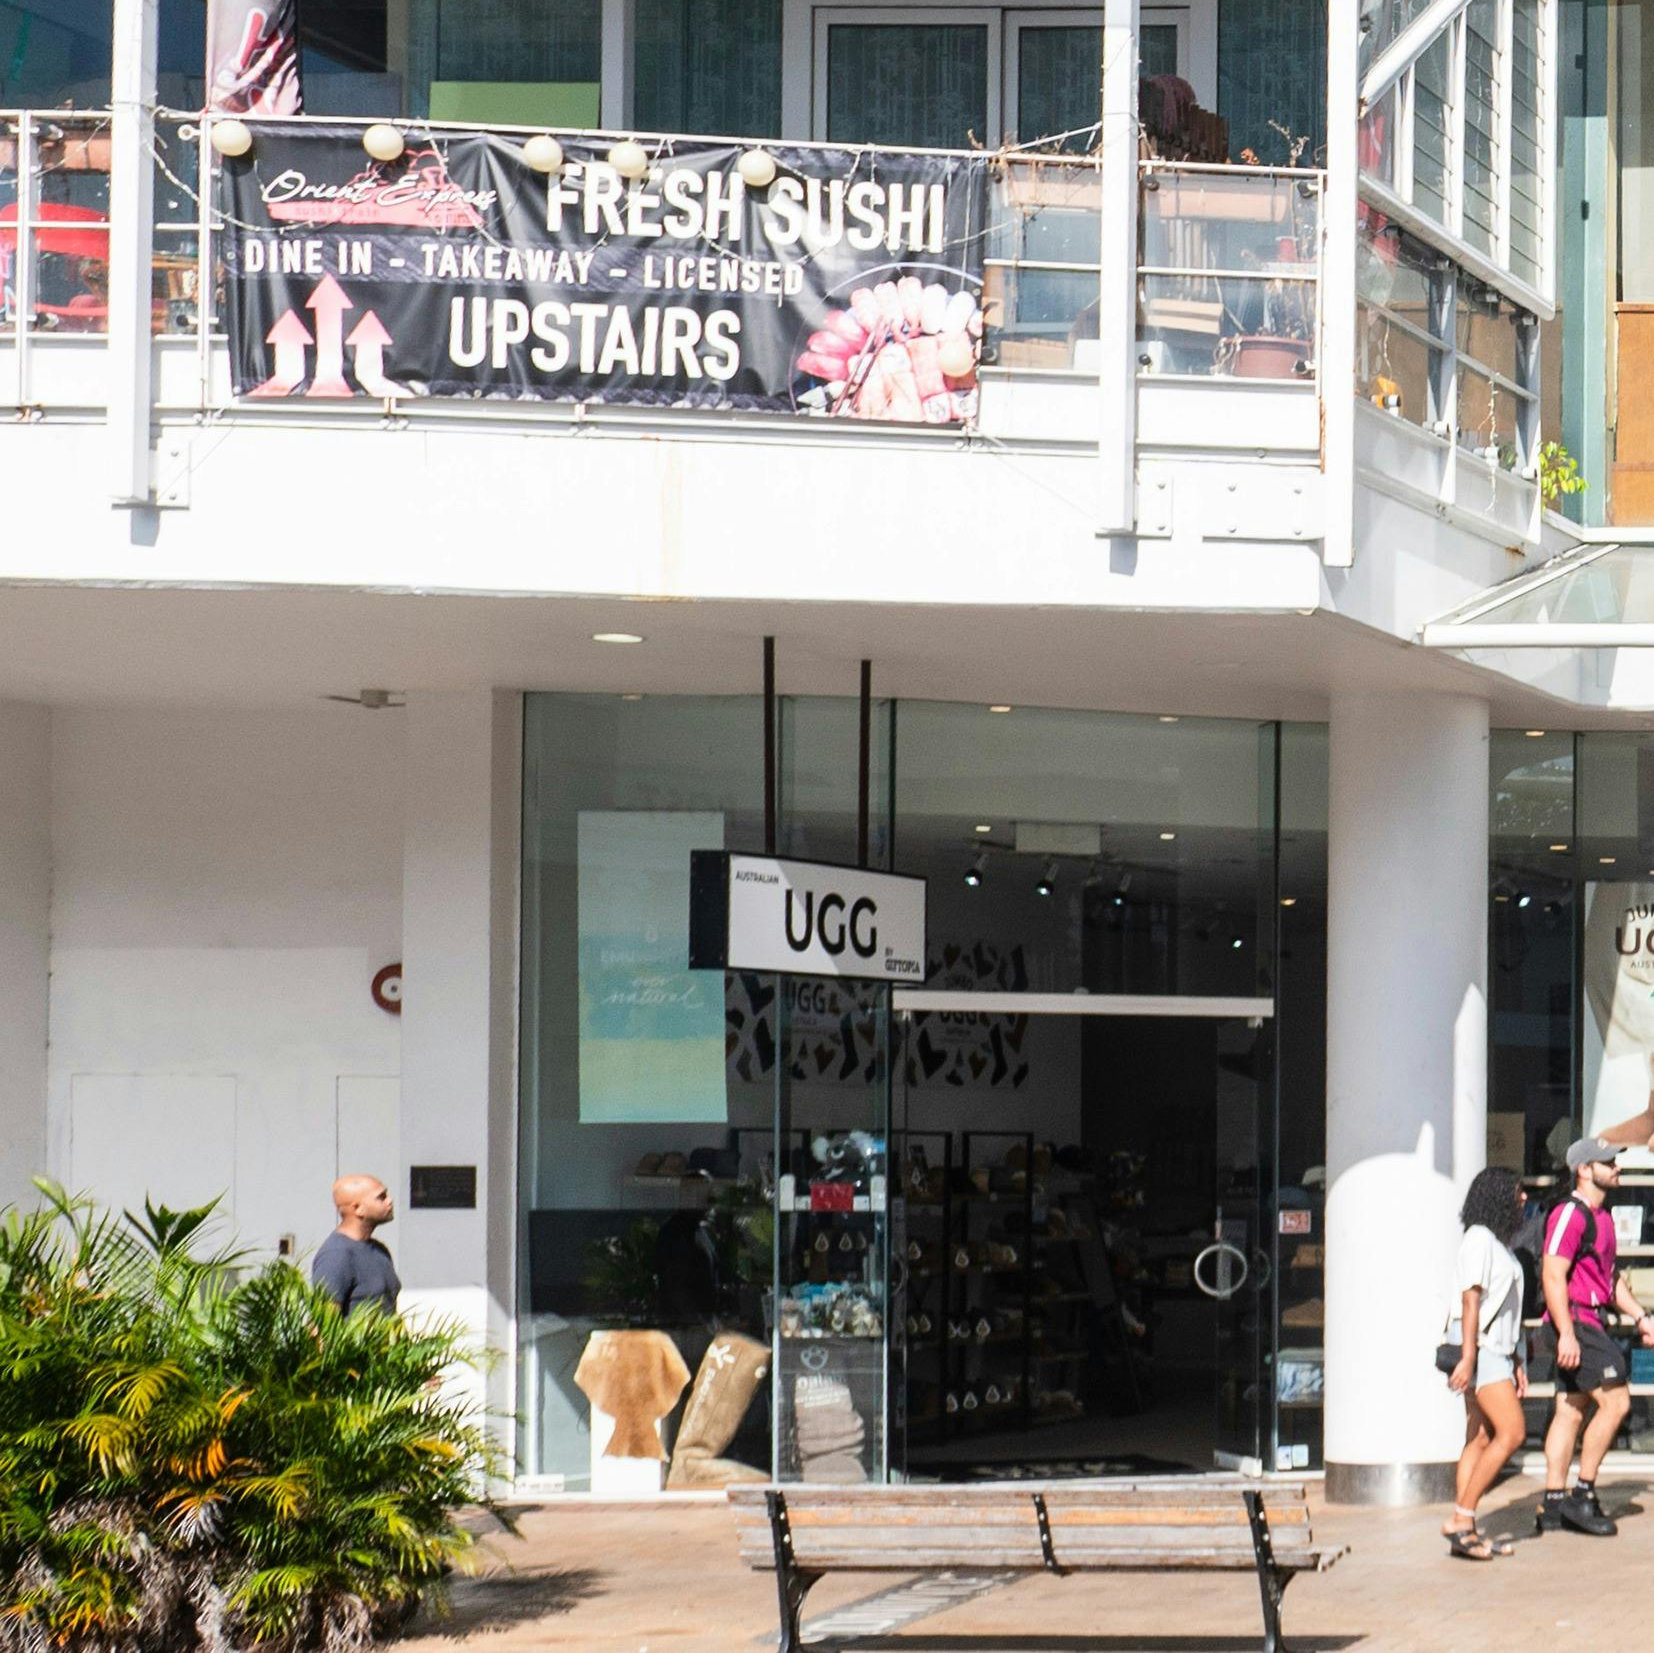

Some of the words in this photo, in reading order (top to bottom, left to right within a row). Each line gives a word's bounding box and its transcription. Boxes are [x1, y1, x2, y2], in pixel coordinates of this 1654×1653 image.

[261, 169, 369, 204] Orient
[376, 173, 498, 213] Express
[546, 161, 744, 242] FRESH
[764, 174, 945, 254] SUSHI
[245, 238, 324, 273] DINE
[338, 241, 373, 275] IN
[421, 244, 595, 285] TAKEAWAY
[643, 254, 806, 295] LICENSED
[449, 295, 741, 382] UPSTAIRS
[735, 871, 779, 884] AUSTRALIAN
[785, 889, 877, 958] UGG
